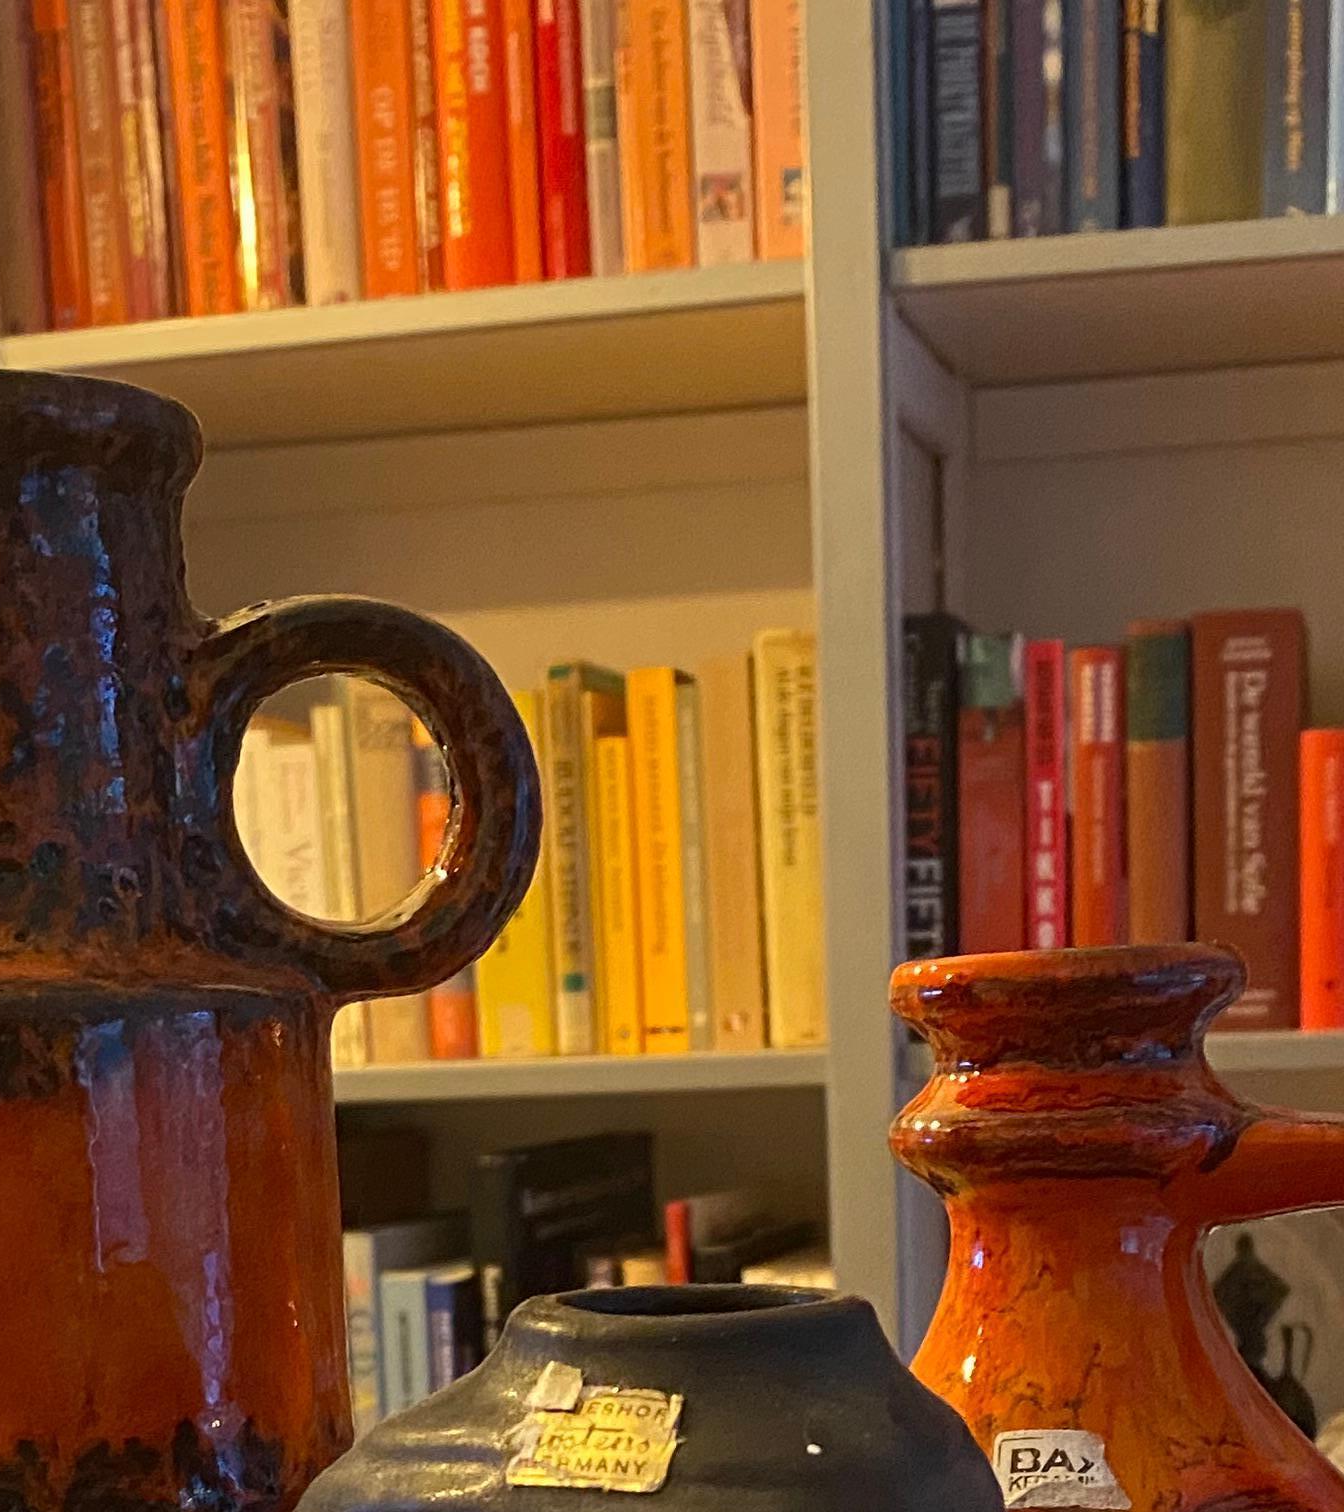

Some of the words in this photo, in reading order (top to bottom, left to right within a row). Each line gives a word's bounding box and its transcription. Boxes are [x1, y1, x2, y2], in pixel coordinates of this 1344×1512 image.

[1242, 672, 1266, 709] De
[1243, 714, 1268, 797] wereld
[908, 737, 943, 858] FIFTY
[1243, 800, 1263, 849] van
[907, 859, 944, 955] FIFT
[1242, 852, 1266, 914] Sofie
